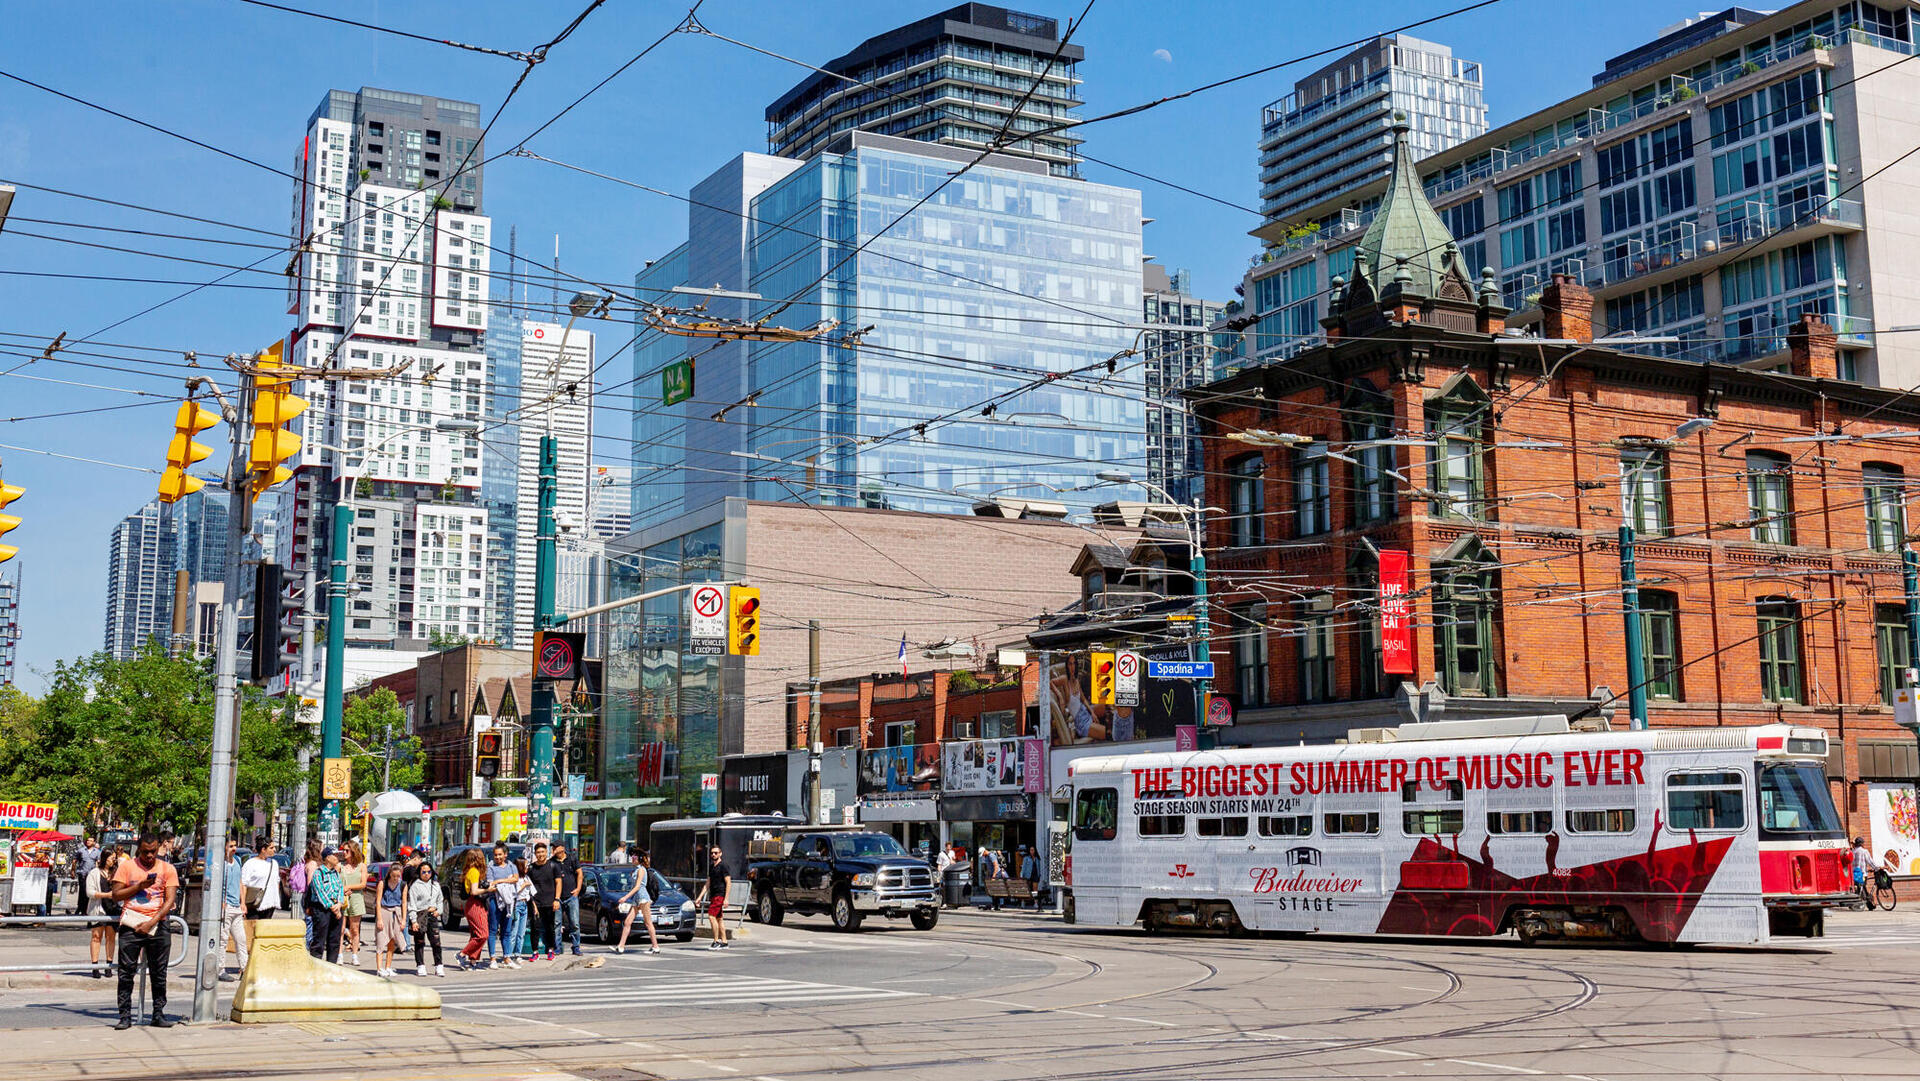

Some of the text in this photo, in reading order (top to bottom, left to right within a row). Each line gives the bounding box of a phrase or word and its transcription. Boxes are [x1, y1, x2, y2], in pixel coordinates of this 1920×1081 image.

[1381, 583, 1402, 597] LIVE
[1382, 599, 1406, 613] LOVE
[1383, 615, 1399, 629] EAT
[695, 646, 721, 654] EXCEPTED
[702, 639, 726, 647] VEHICLES
[1384, 639, 1407, 651] BASIL
[1157, 663, 1193, 675] Spadina
[1029, 741, 1040, 791] ARDENE
[1131, 748, 1646, 798] THE BIGGEST SUMMER OF MUSIC EVER
[739, 775, 769, 791] DUEWEST
[0, 803, 54, 821] Hot Dog
[1133, 798, 1301, 815] STAGE SEASON STARTS MAY 24TH
[8, 819, 39, 829] Poutine
[1552, 868, 1571, 877] 4082
[1249, 867, 1363, 894] Budweiser
[1279, 897, 1334, 911] STAGE
